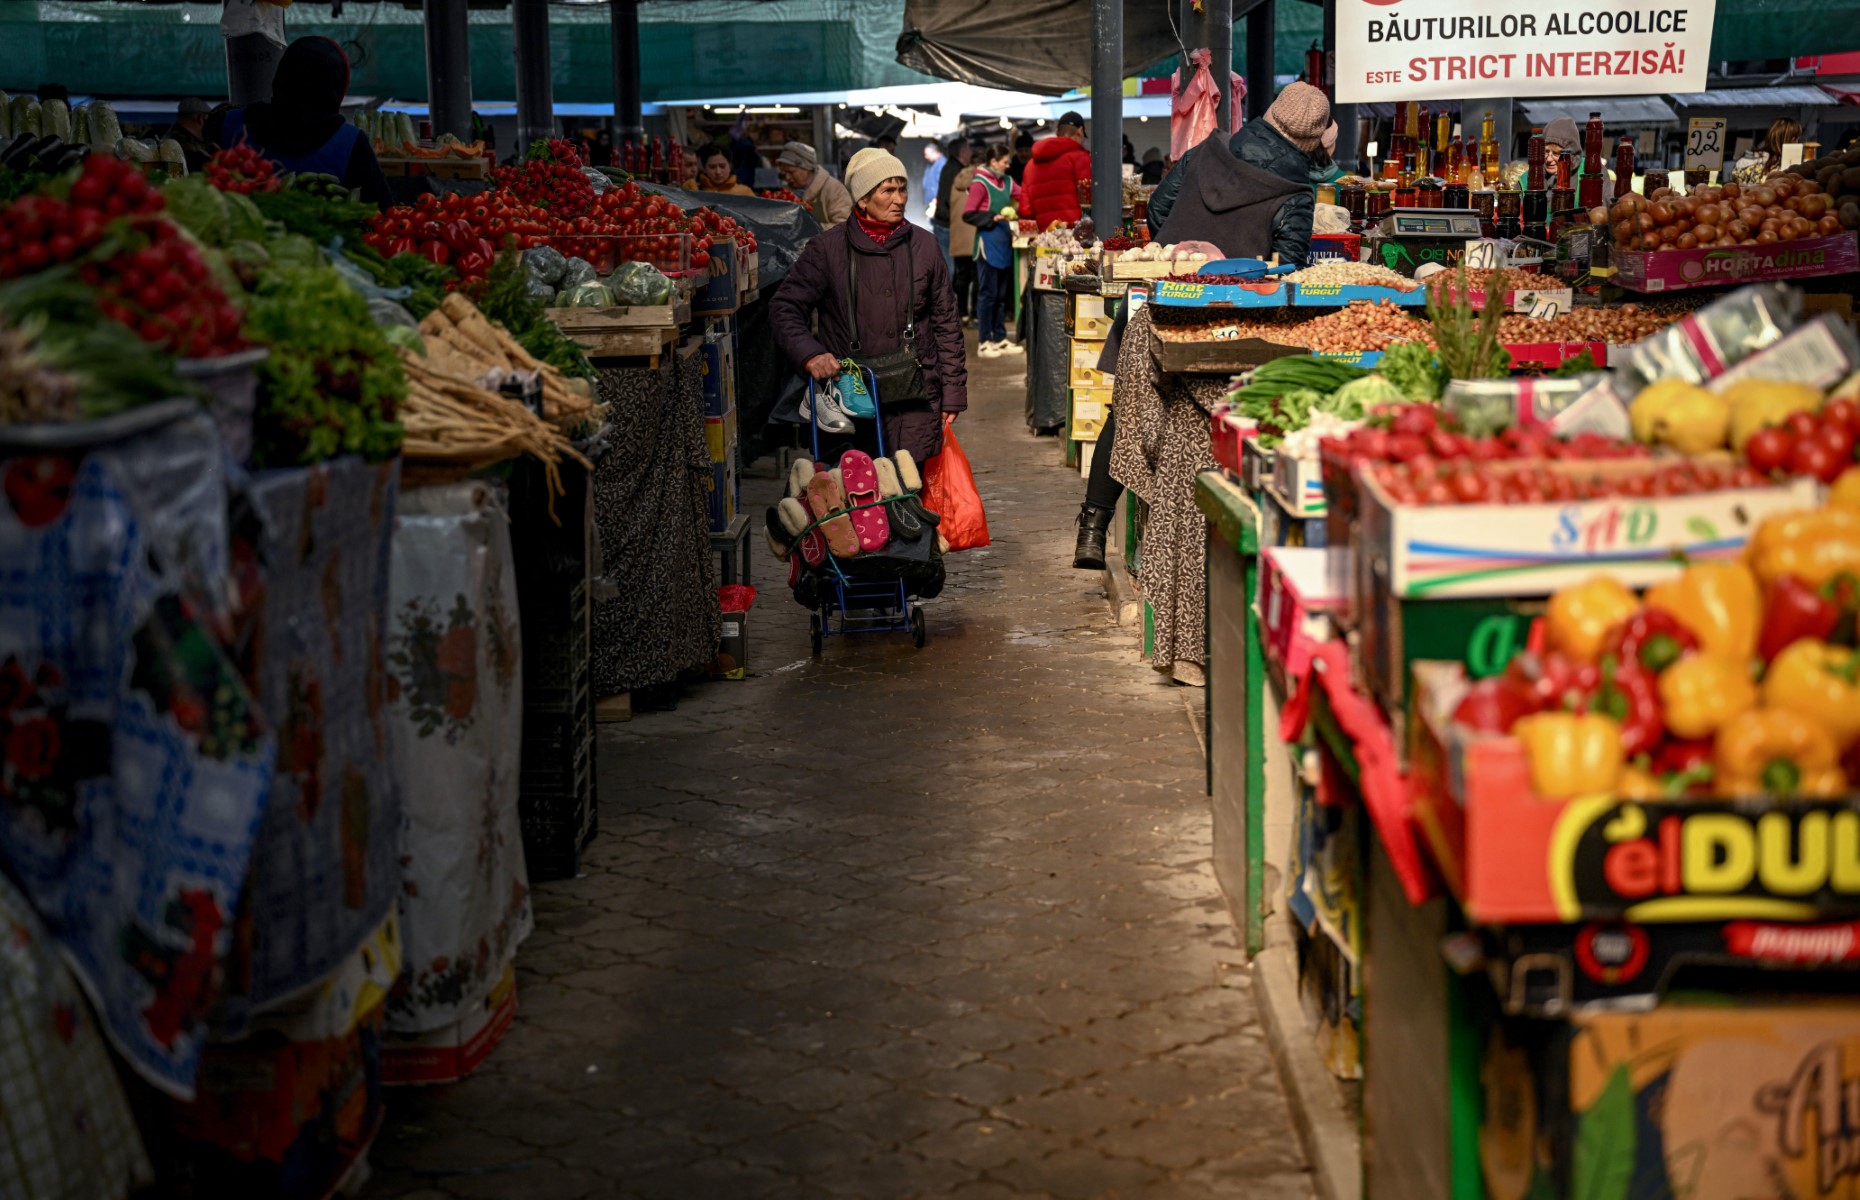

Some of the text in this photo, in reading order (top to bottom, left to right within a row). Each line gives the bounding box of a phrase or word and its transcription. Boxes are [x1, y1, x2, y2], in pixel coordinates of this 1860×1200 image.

[1368, 9, 1688, 42] BĂUTURILOR ALCOOLICE
[1366, 42, 1685, 84] ESTE STRICT INTERZISĂ!
[1687, 130, 1719, 156] 22
[1420, 248, 1445, 260] BIO
[1163, 281, 1205, 292] Rifat
[1300, 288, 1342, 296] TURGUT
[1161, 291, 1203, 299] TURGUT
